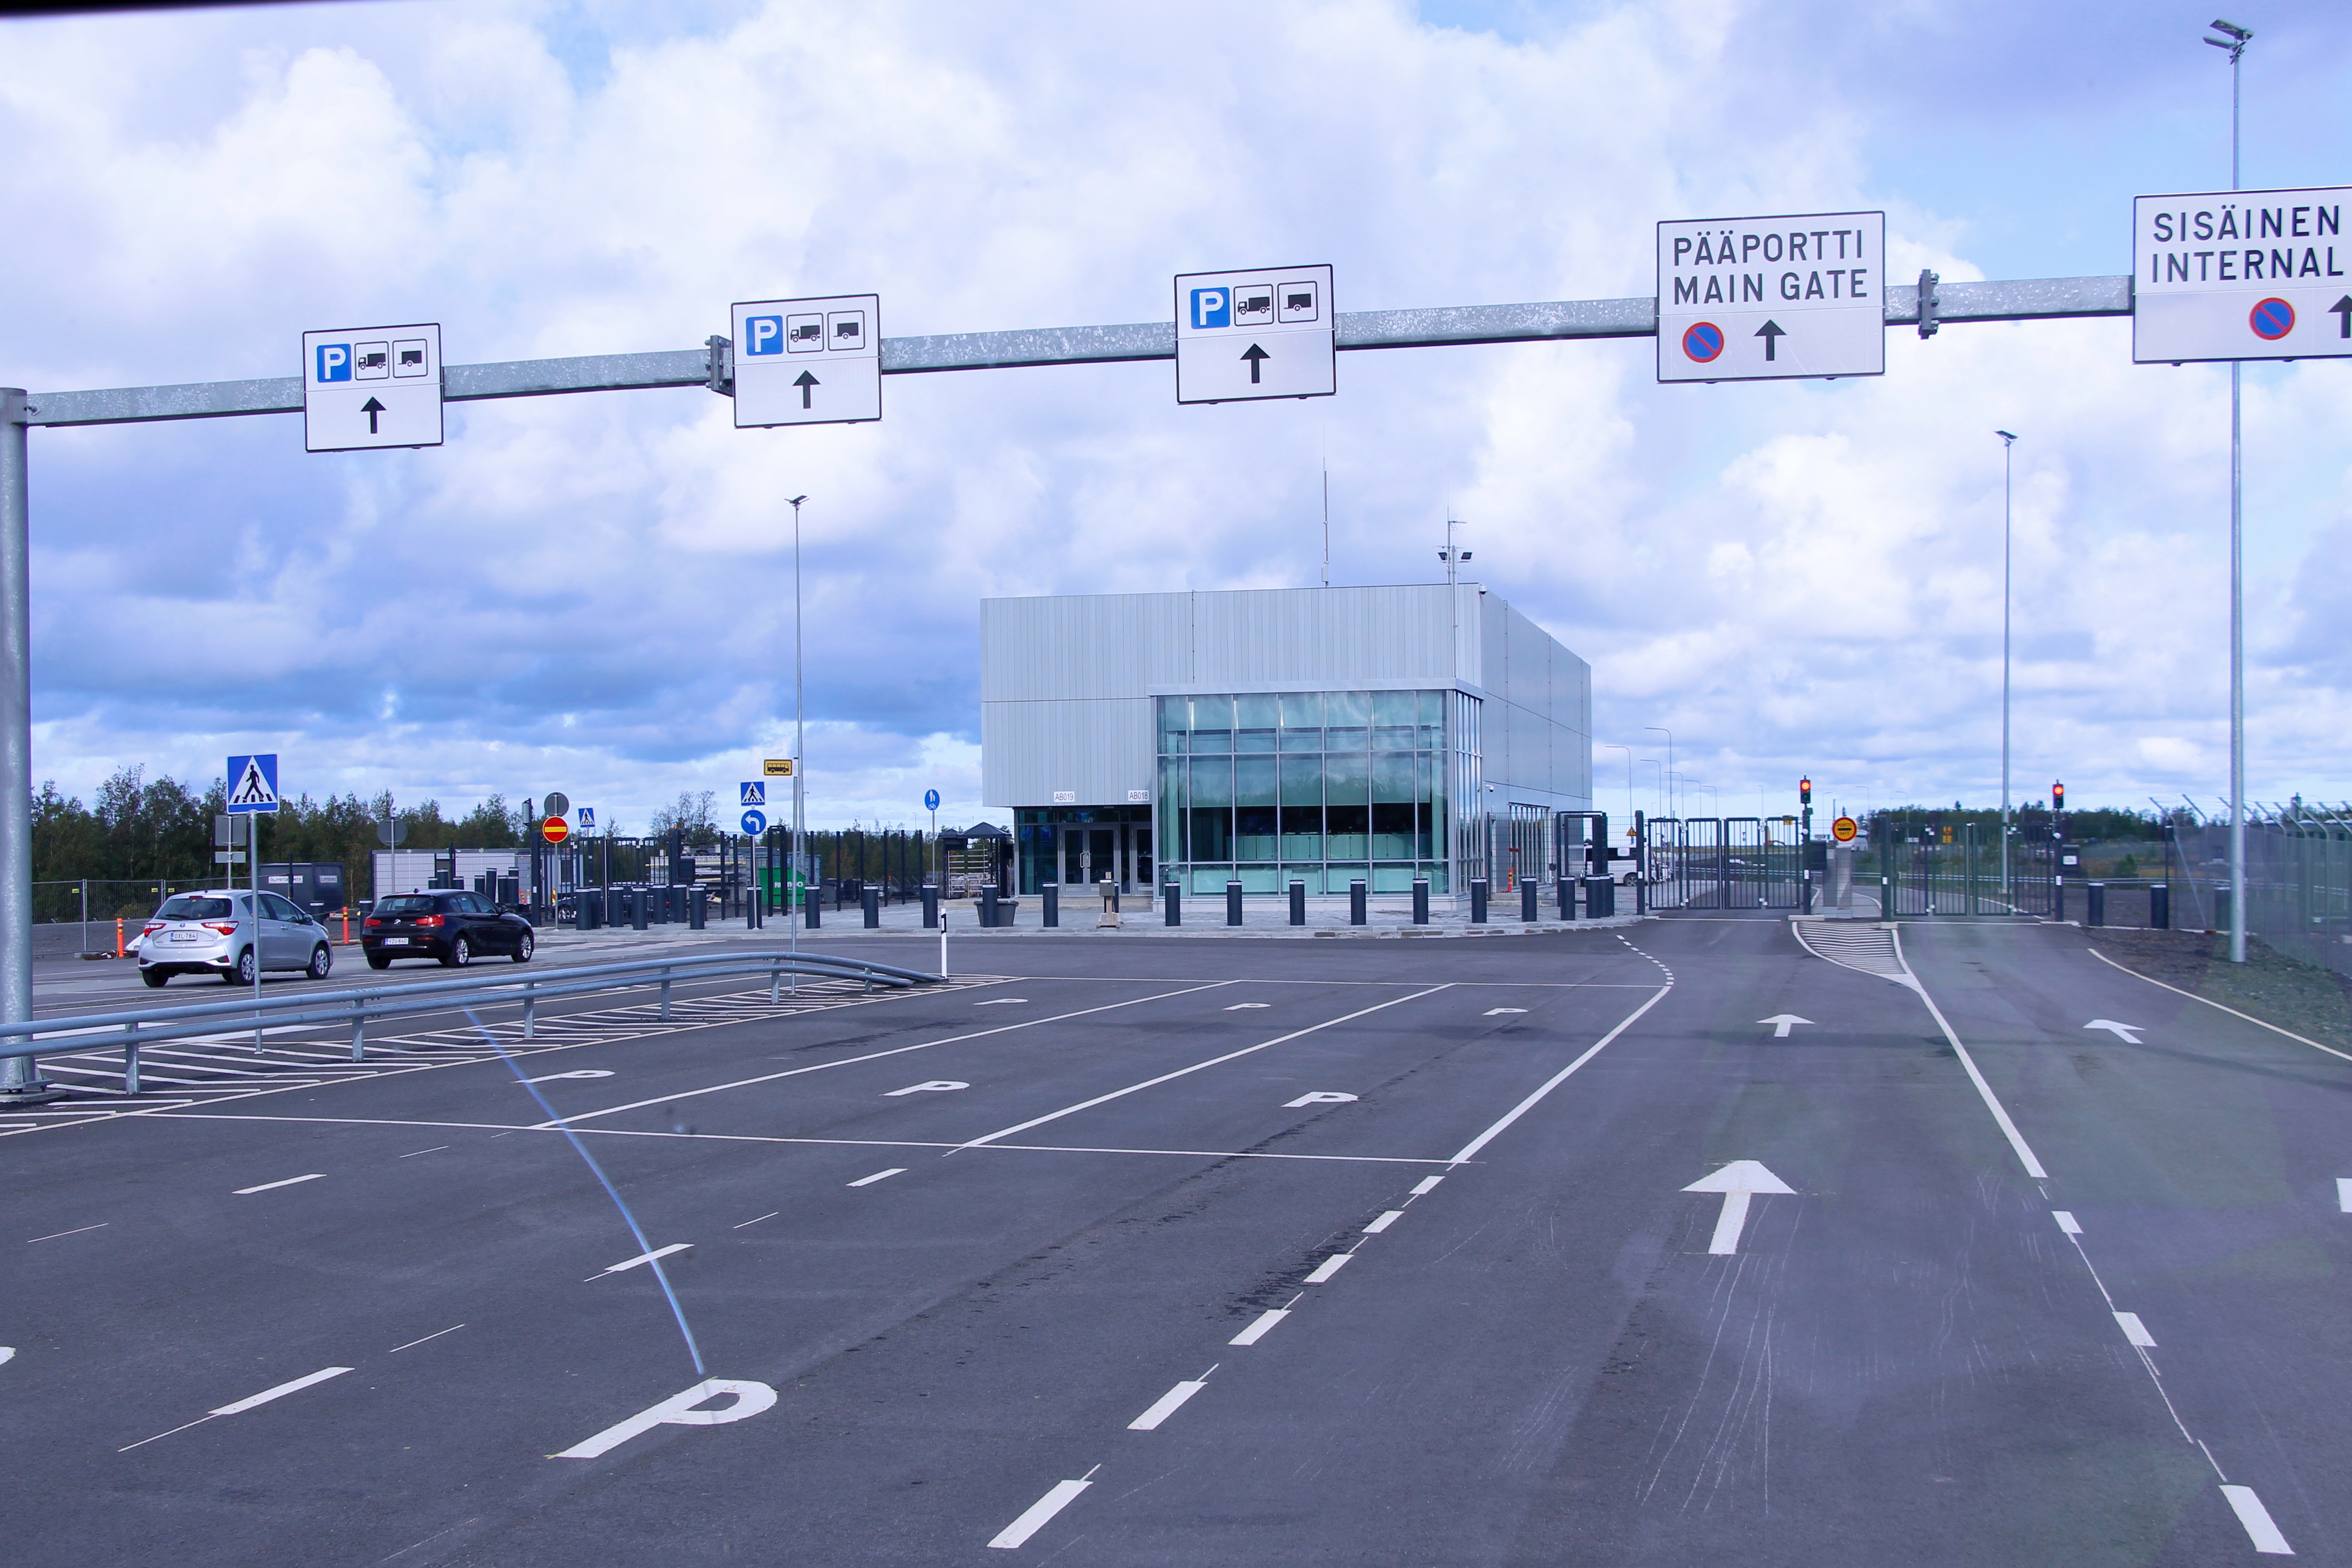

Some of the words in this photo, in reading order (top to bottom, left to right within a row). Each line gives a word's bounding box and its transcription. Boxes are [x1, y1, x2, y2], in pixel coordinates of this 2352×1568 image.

[2153, 204, 2339, 243] SISÄINEN
[1674, 229, 1862, 266] PÄÄPORTTI
[2152, 247, 2343, 283] INTERNAL
[1674, 273, 1762, 305] MAIN
[1780, 269, 1867, 300] GATE
[1199, 291, 1224, 326] P
[754, 319, 777, 352] P
[324, 347, 346, 379] P
[1055, 793, 1073, 801] AB019
[1129, 792, 1148, 800] AB018
[882, 1080, 970, 1096] P
[1281, 1091, 1359, 1107] P
[554, 1378, 778, 1458] P
